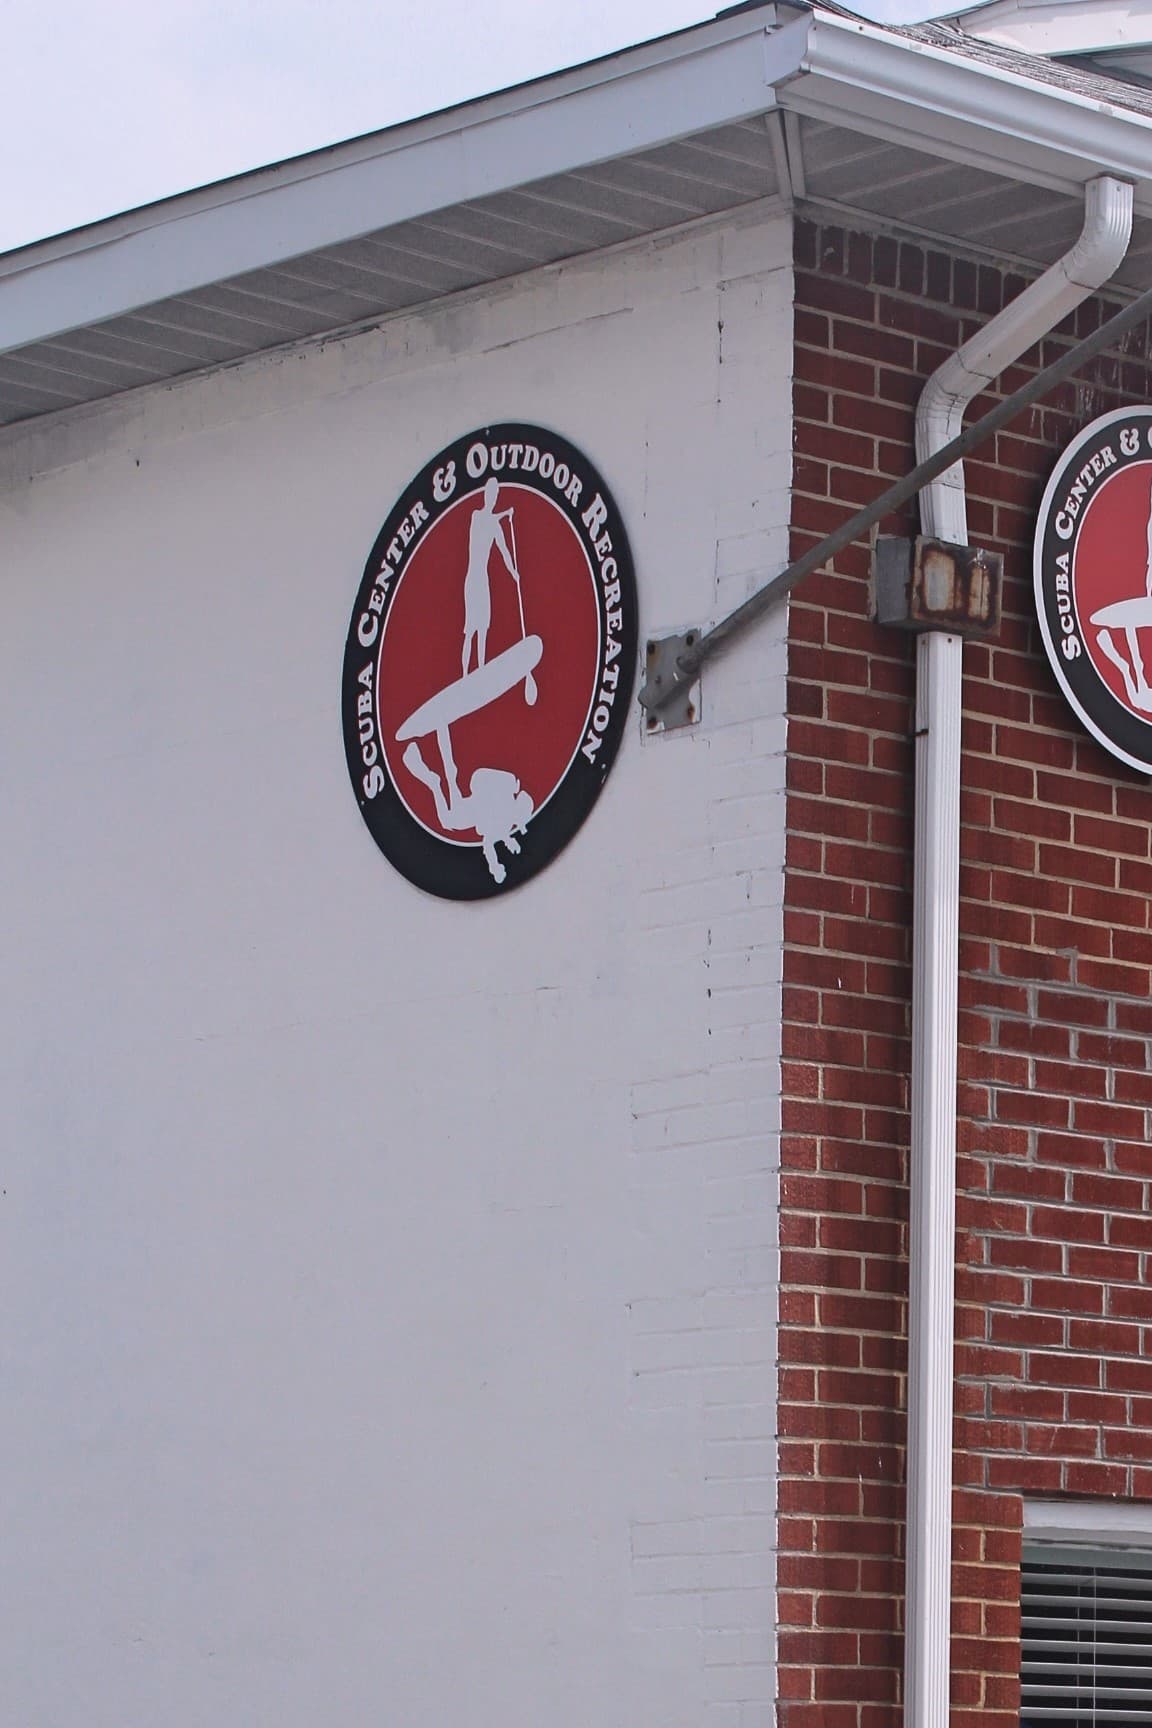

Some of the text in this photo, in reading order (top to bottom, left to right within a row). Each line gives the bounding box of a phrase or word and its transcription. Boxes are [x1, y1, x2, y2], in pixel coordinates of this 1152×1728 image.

[1055, 445, 1118, 540] CENTER
[1119, 428, 1141, 456] &
[357, 442, 624, 800] SCUBA CENTER & OUTDOOR RECREATION
[1056, 552, 1082, 661] SCUBA
